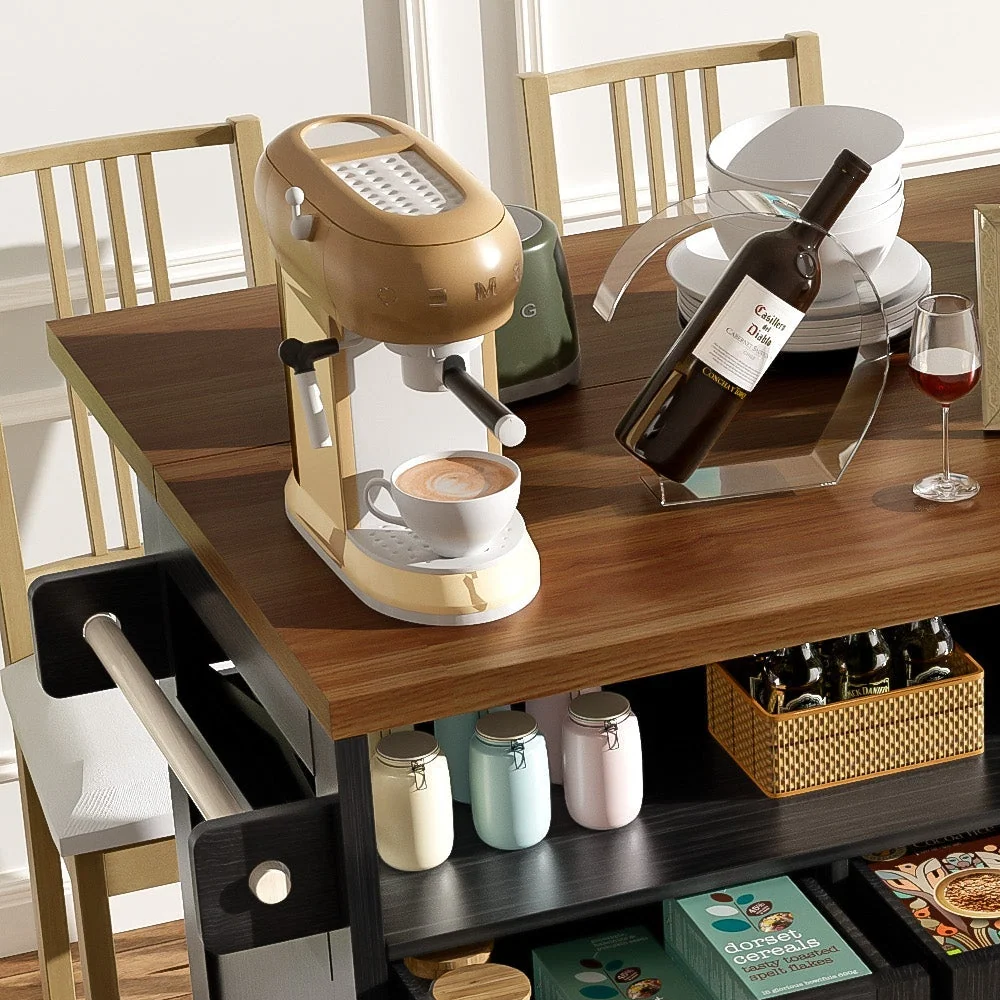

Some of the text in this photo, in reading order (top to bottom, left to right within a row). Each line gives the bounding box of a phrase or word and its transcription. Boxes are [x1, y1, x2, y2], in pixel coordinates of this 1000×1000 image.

[746, 323, 773, 347] Diablo
[724, 929, 802, 954] dorset
[733, 937, 820, 965] cereals
[742, 945, 840, 973] tasty toasted
[749, 956, 834, 982] spelt flakes
[771, 982, 803, 994] glorious
[804, 974, 837, 987] bowlfuls
